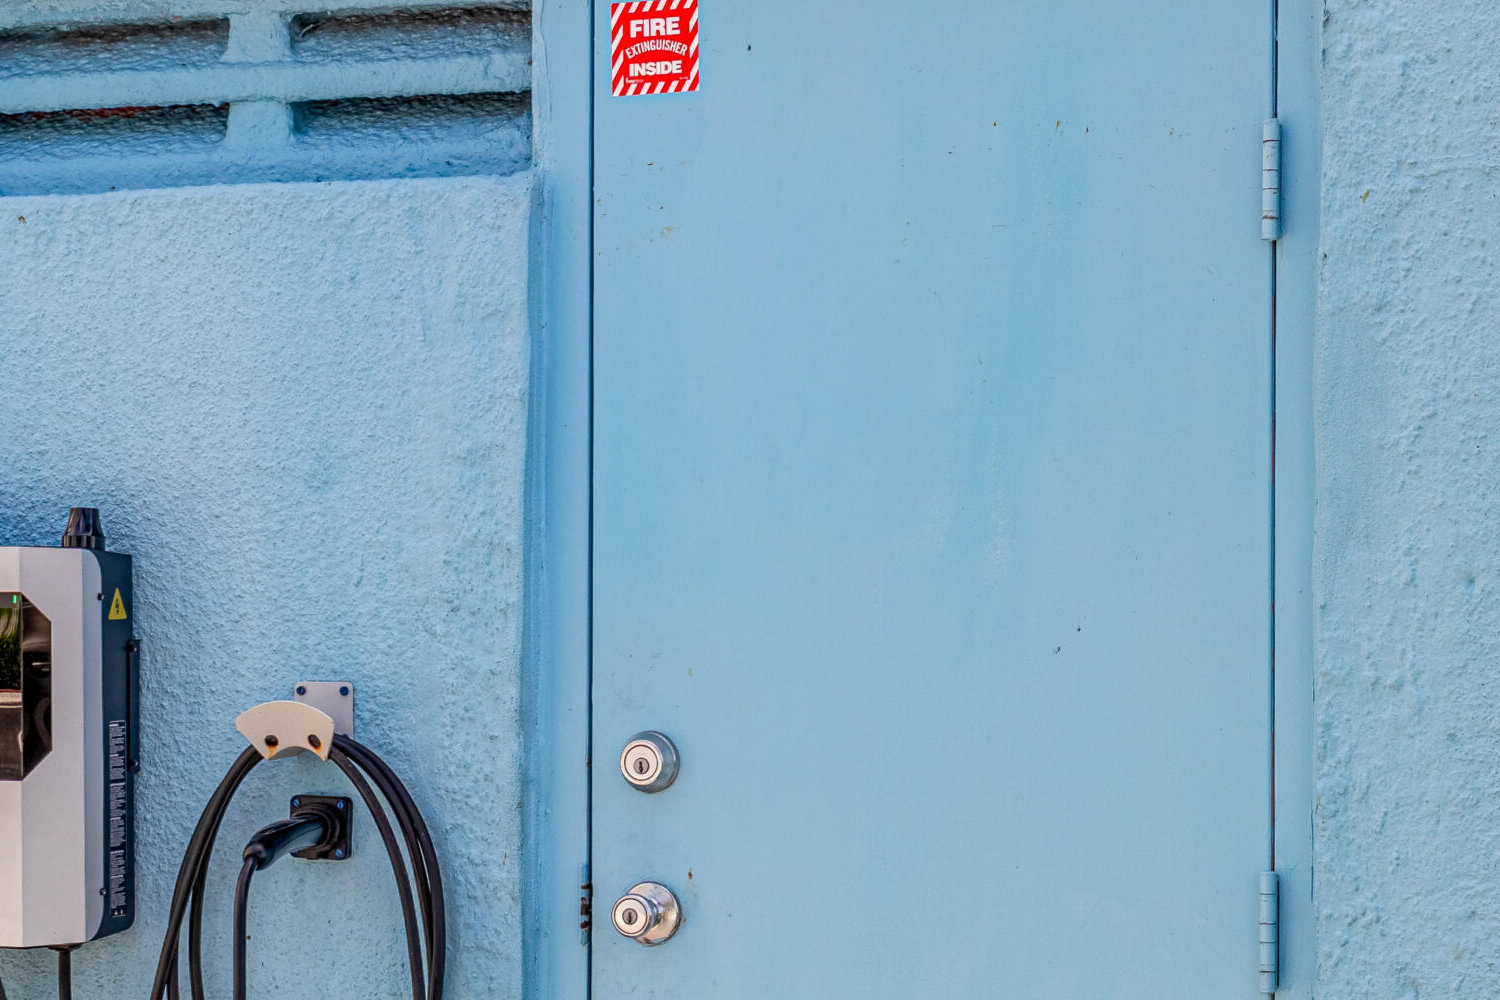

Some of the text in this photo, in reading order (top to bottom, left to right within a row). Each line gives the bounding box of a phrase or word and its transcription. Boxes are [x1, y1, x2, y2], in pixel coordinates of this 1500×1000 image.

[630, 16, 681, 38] FIRE
[624, 39, 688, 59] EXTINGUISHER
[629, 60, 682, 77] INSIDE
